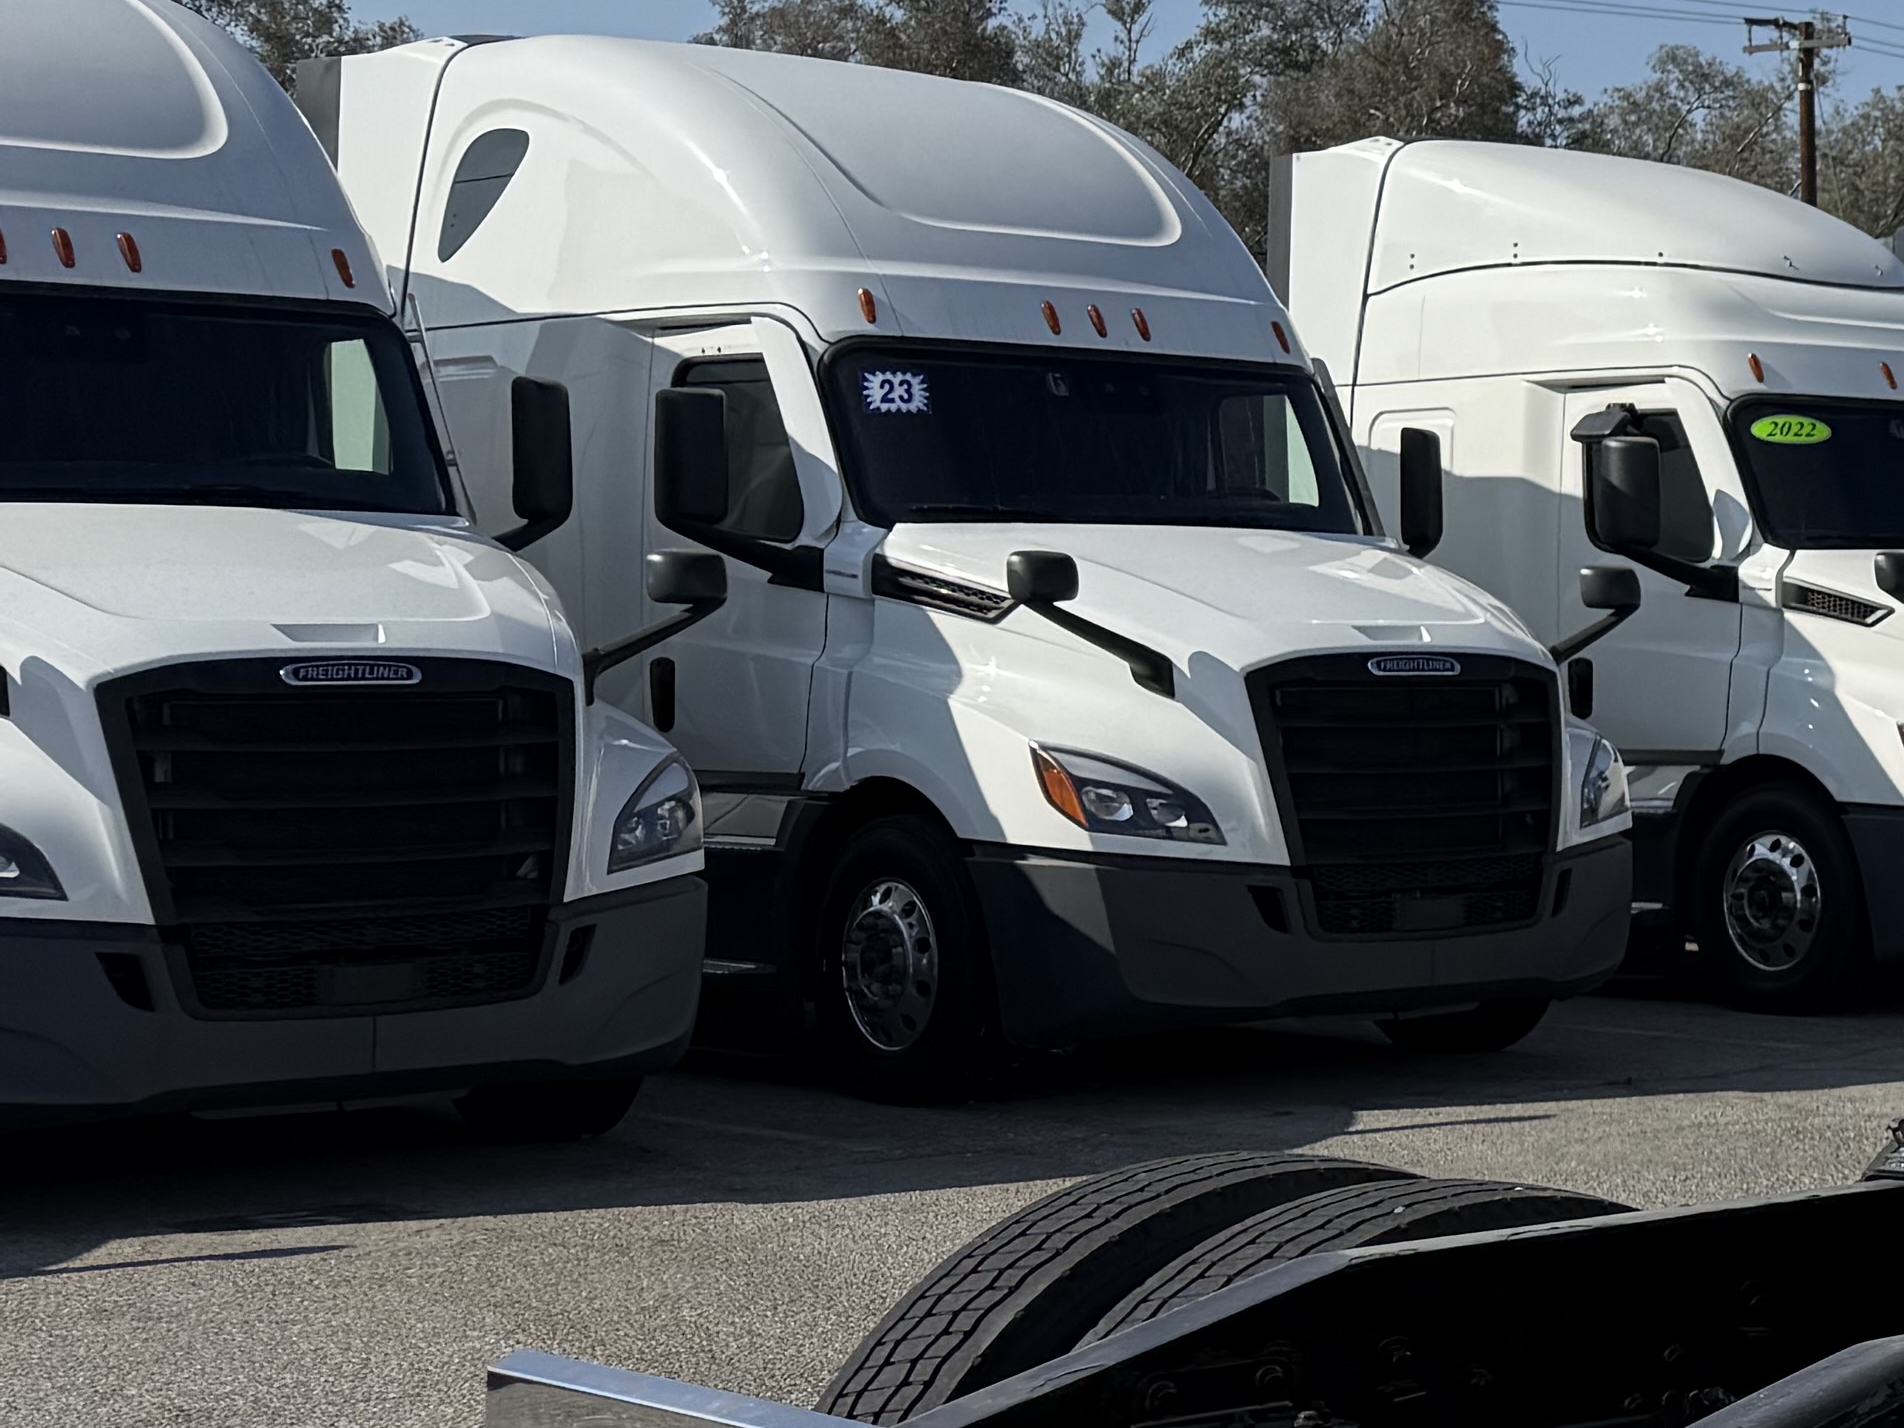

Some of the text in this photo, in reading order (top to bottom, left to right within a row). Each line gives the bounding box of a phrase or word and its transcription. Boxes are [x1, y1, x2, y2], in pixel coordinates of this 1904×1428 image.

[880, 378, 913, 404] 23
[1766, 420, 1817, 438] 2022
[298, 664, 408, 680] FREIGHTLINER
